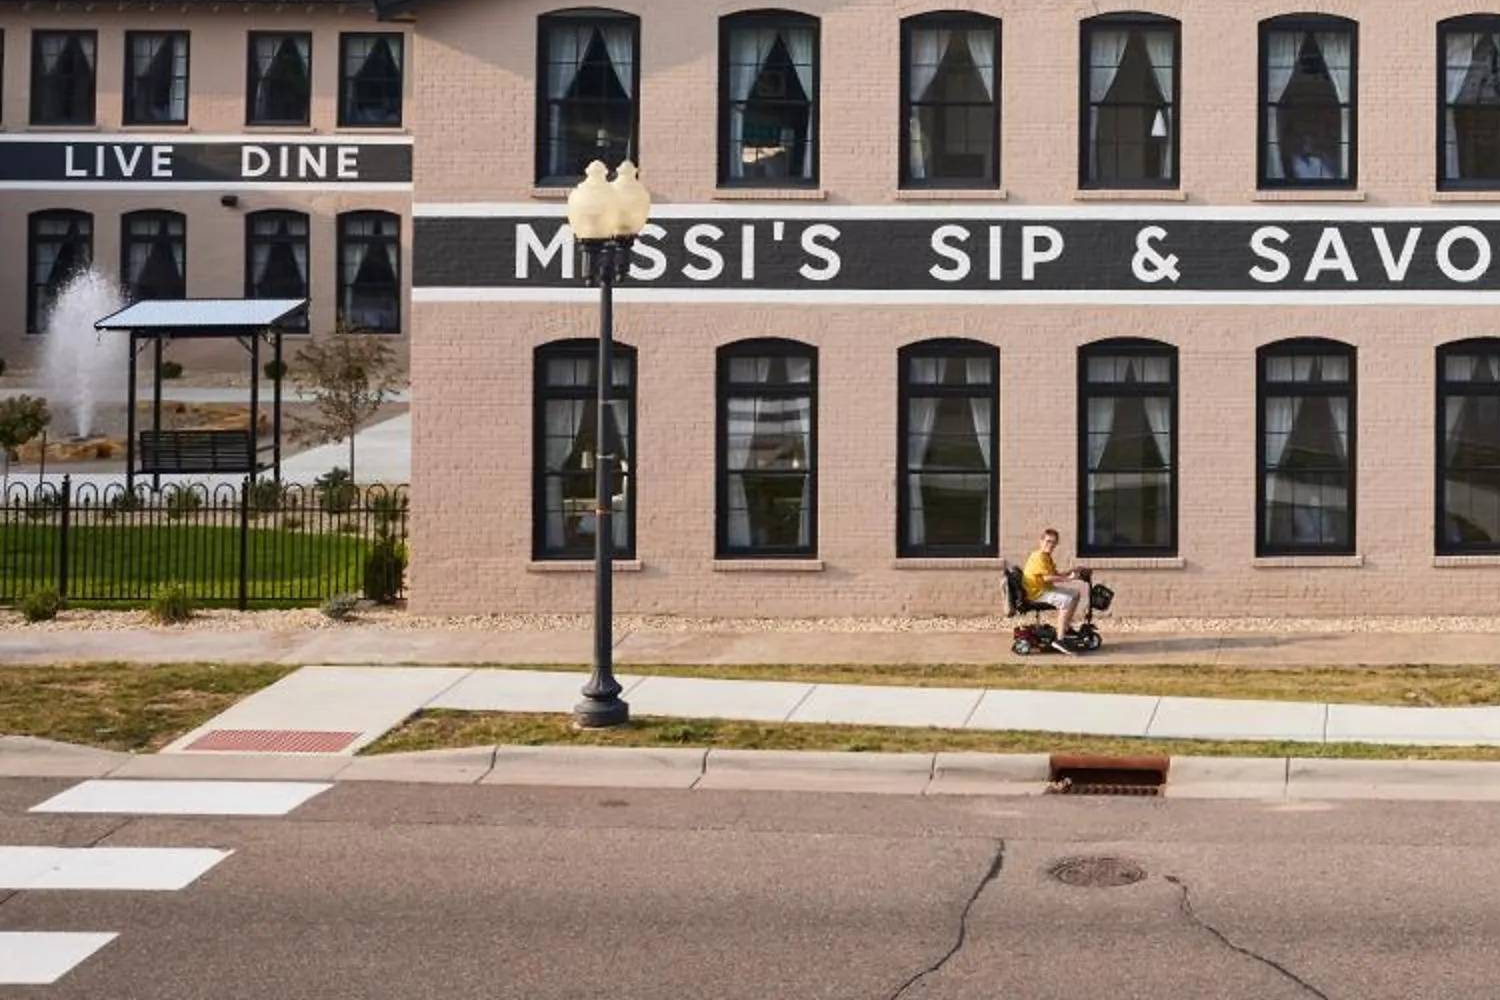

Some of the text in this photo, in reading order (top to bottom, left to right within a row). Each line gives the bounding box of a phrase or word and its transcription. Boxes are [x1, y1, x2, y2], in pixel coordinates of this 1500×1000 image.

[65, 145, 360, 178] LIVE DINE
[514, 222, 843, 282] MSSI'S
[928, 224, 1065, 282] SIP
[1131, 225, 1182, 283] &
